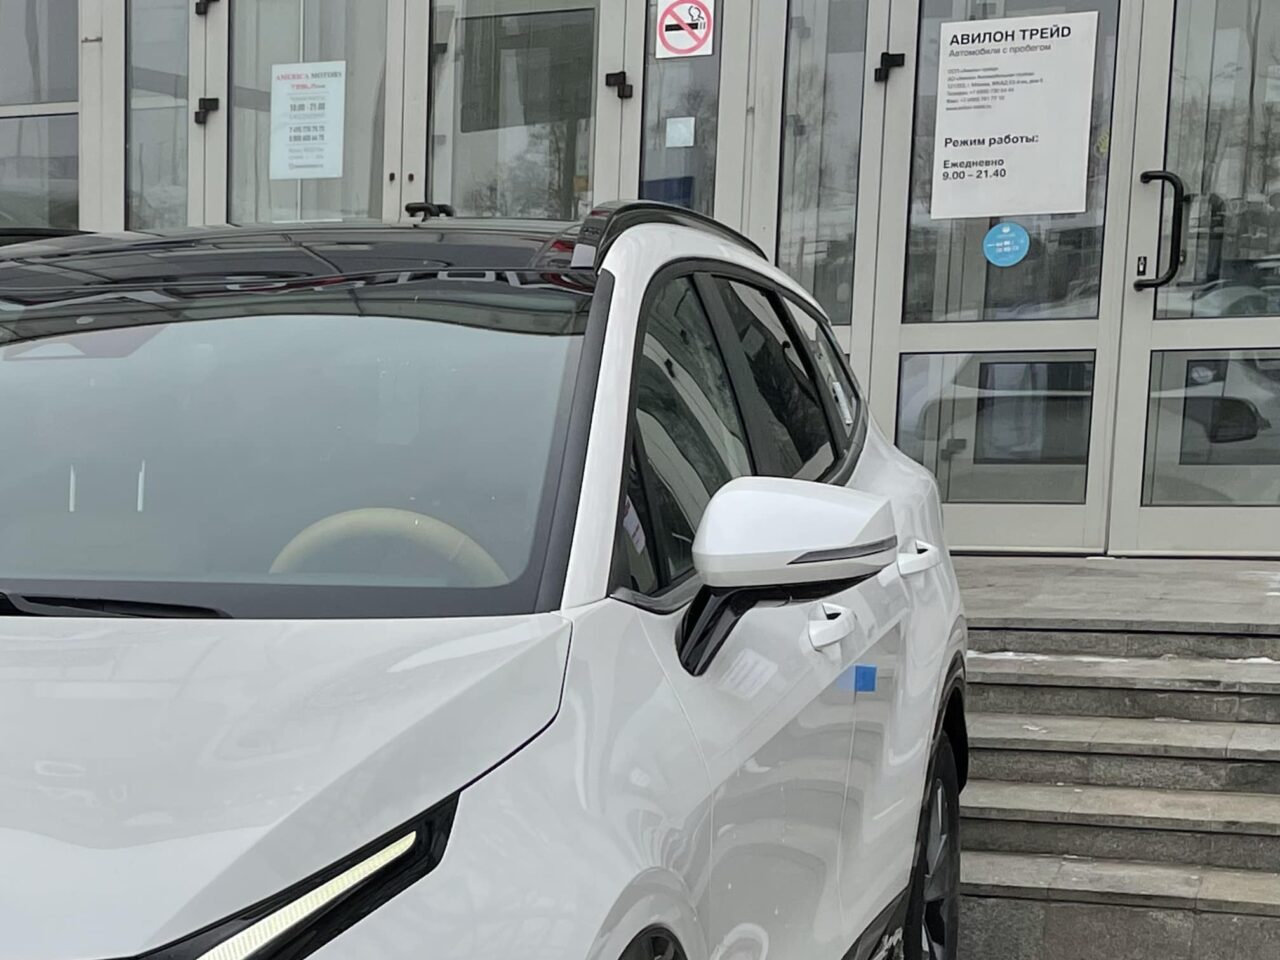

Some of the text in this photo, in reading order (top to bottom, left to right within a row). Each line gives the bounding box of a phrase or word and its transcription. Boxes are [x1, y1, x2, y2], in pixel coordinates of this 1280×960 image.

[949, 30, 1015, 46] АВИЛОН
[948, 48, 1000, 57] Автомобили
[1009, 43, 1052, 54] пробегом
[944, 133, 1039, 148] Режим работы:
[943, 158, 1004, 169] Ежедневно
[942, 170, 966, 181] 9.00
[976, 168, 1007, 179] 21.40
